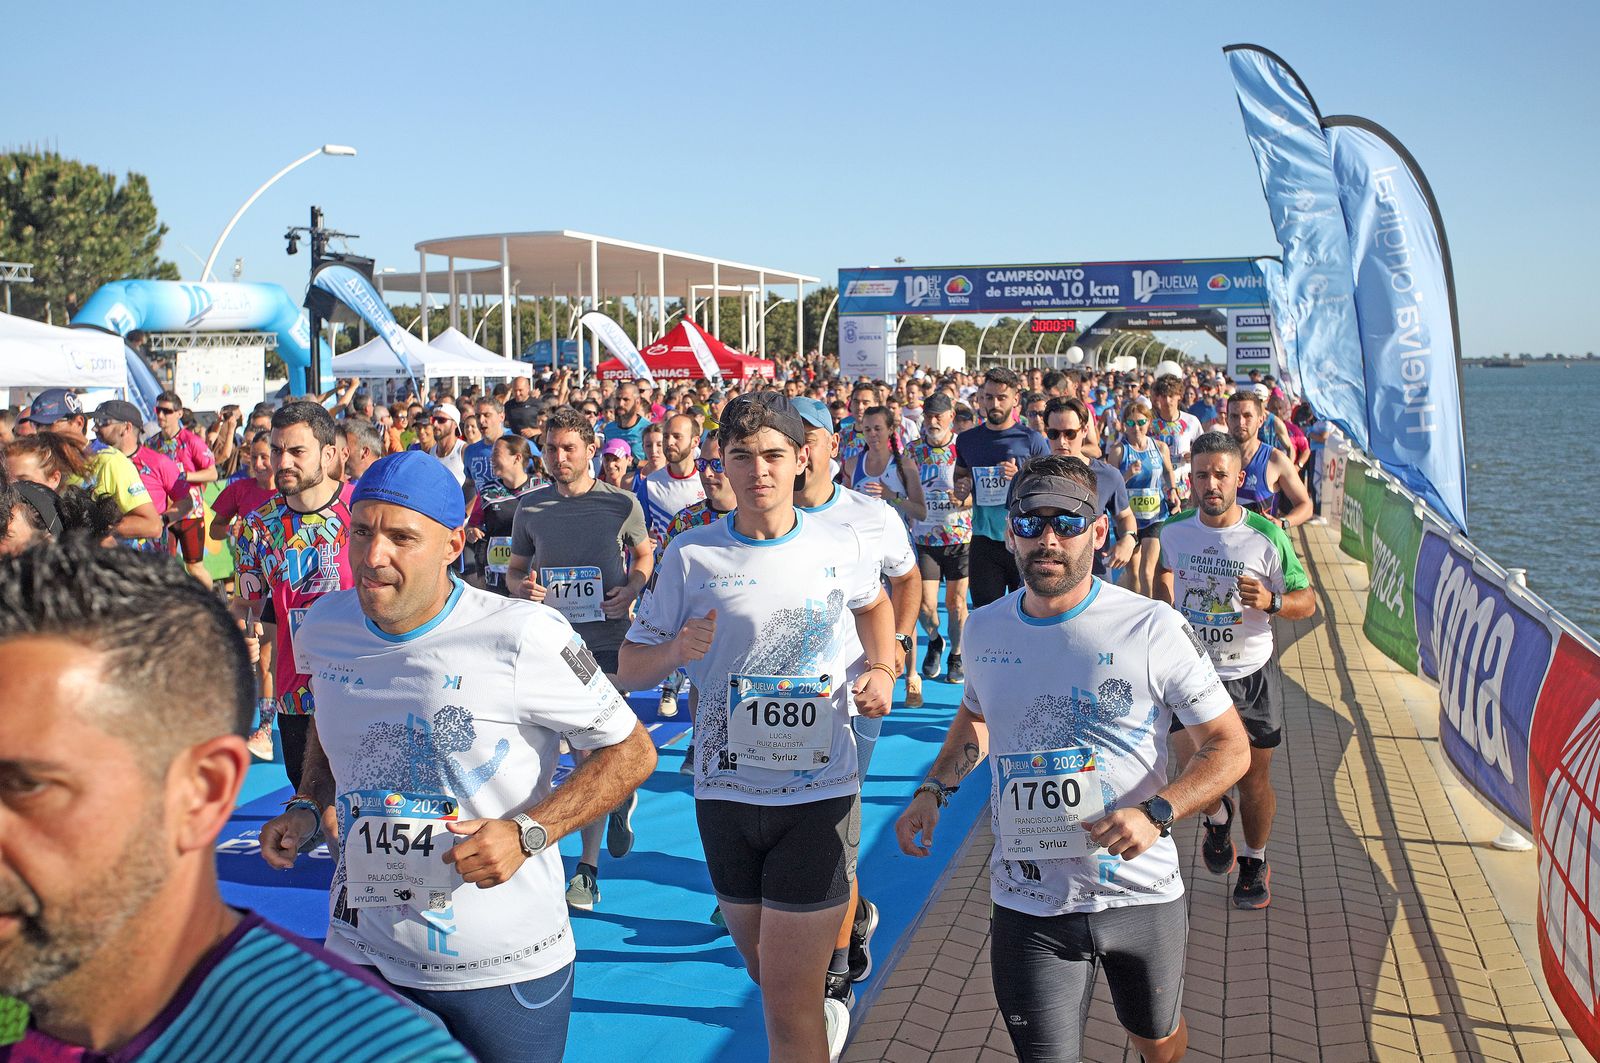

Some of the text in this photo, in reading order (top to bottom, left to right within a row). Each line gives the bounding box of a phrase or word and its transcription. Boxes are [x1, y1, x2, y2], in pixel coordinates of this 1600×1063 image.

[986, 268, 1084, 283] CAMPEONATO
[1159, 275, 1198, 289] HUELVA
[986, 280, 1119, 298] de ESPAÑA 10 km
[1051, 298, 1084, 306] Absoluto
[1085, 299, 1091, 307] y
[602, 368, 690, 379] SPORANIACS
[980, 477, 1006, 489] 1230
[926, 501, 951, 511] 1344
[1132, 497, 1155, 506] 1260
[1190, 554, 1213, 565] GRAN
[1216, 558, 1245, 569] FONDO
[580, 569, 597, 578] 2023
[1198, 565, 1243, 578] GUADIAMAR
[552, 581, 594, 598] 1716
[699, 578, 758, 590] JORMA
[975, 656, 1022, 664] JORMA
[752, 683, 775, 692] HUELVA
[798, 682, 823, 694] 2023
[746, 701, 817, 727] 1680
[738, 753, 798, 762] HYUNDAI Syrluz
[1010, 761, 1030, 771] HUELVA
[1053, 755, 1085, 770] 2023
[1010, 778, 1081, 811] 1760
[362, 797, 382, 808] HUELVA
[1014, 814, 1079, 825] FRANCISCO JAVIER
[359, 821, 434, 857] 1454
[1039, 839, 1068, 849] Syrluz
[367, 873, 404, 882] PALACIOS
[354, 895, 387, 903] HYUNDAI
